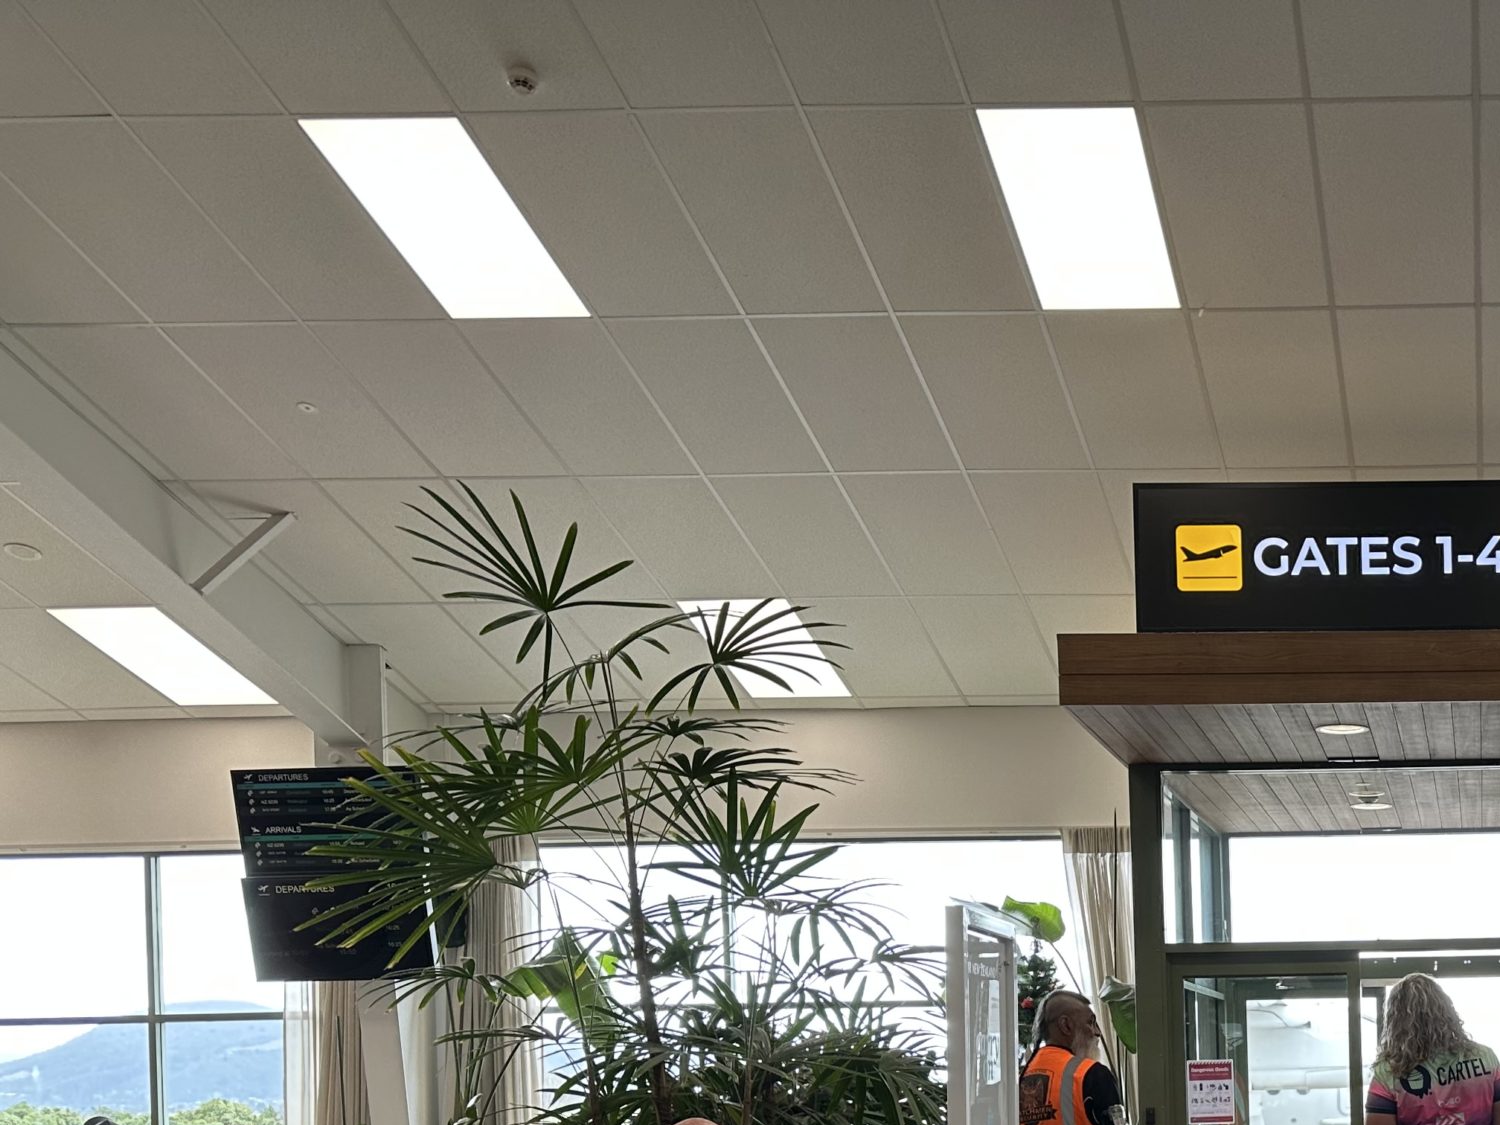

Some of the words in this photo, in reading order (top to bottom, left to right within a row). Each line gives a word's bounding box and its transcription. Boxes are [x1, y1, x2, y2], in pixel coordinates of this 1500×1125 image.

[1253, 536, 1423, 577] GATES
[258, 773, 309, 782] DEPARTURES
[264, 825, 302, 834] ARRIVALS
[1436, 1057, 1492, 1087] CARTEL
